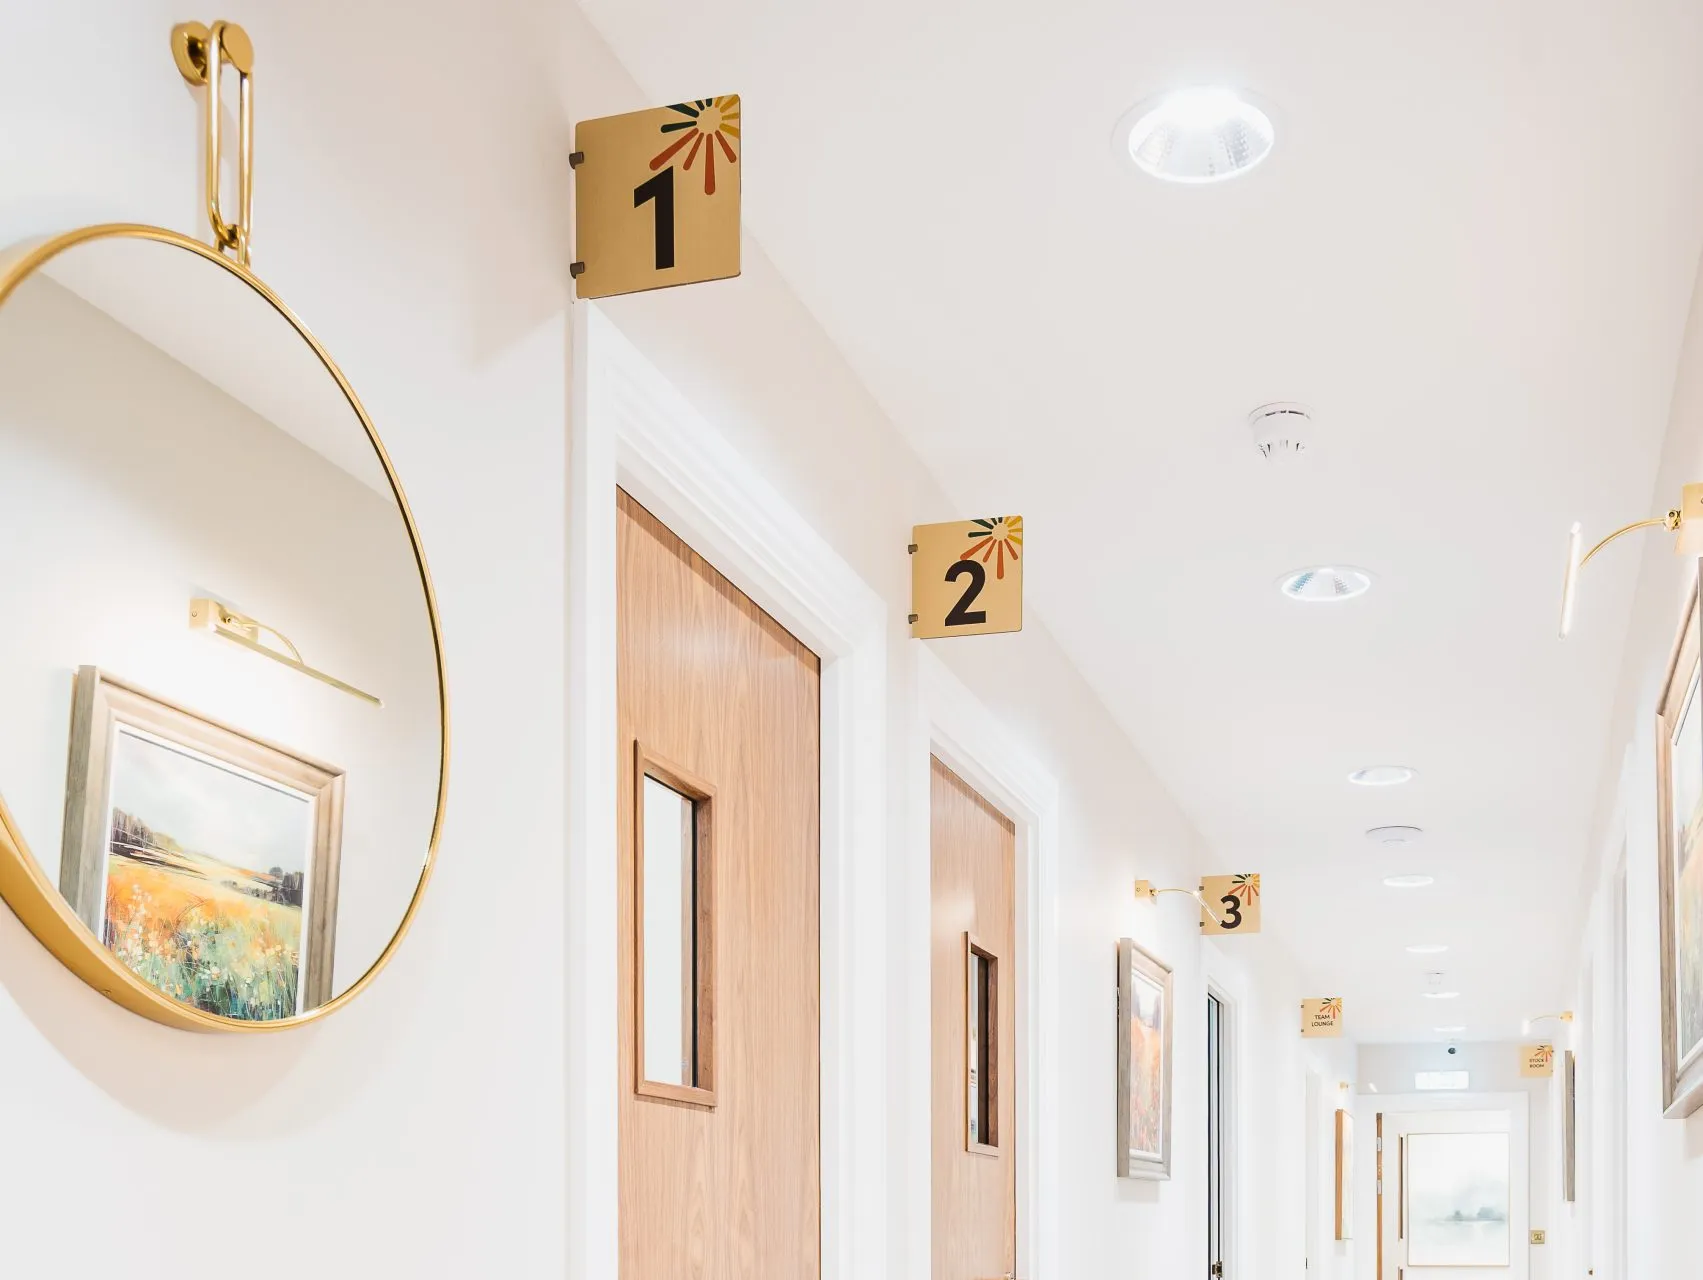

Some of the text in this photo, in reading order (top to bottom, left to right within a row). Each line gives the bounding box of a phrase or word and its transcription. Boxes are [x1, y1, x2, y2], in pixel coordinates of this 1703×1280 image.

[633, 165, 675, 270] 1
[944, 559, 986, 627] 2
[1220, 894, 1242, 930] 3
